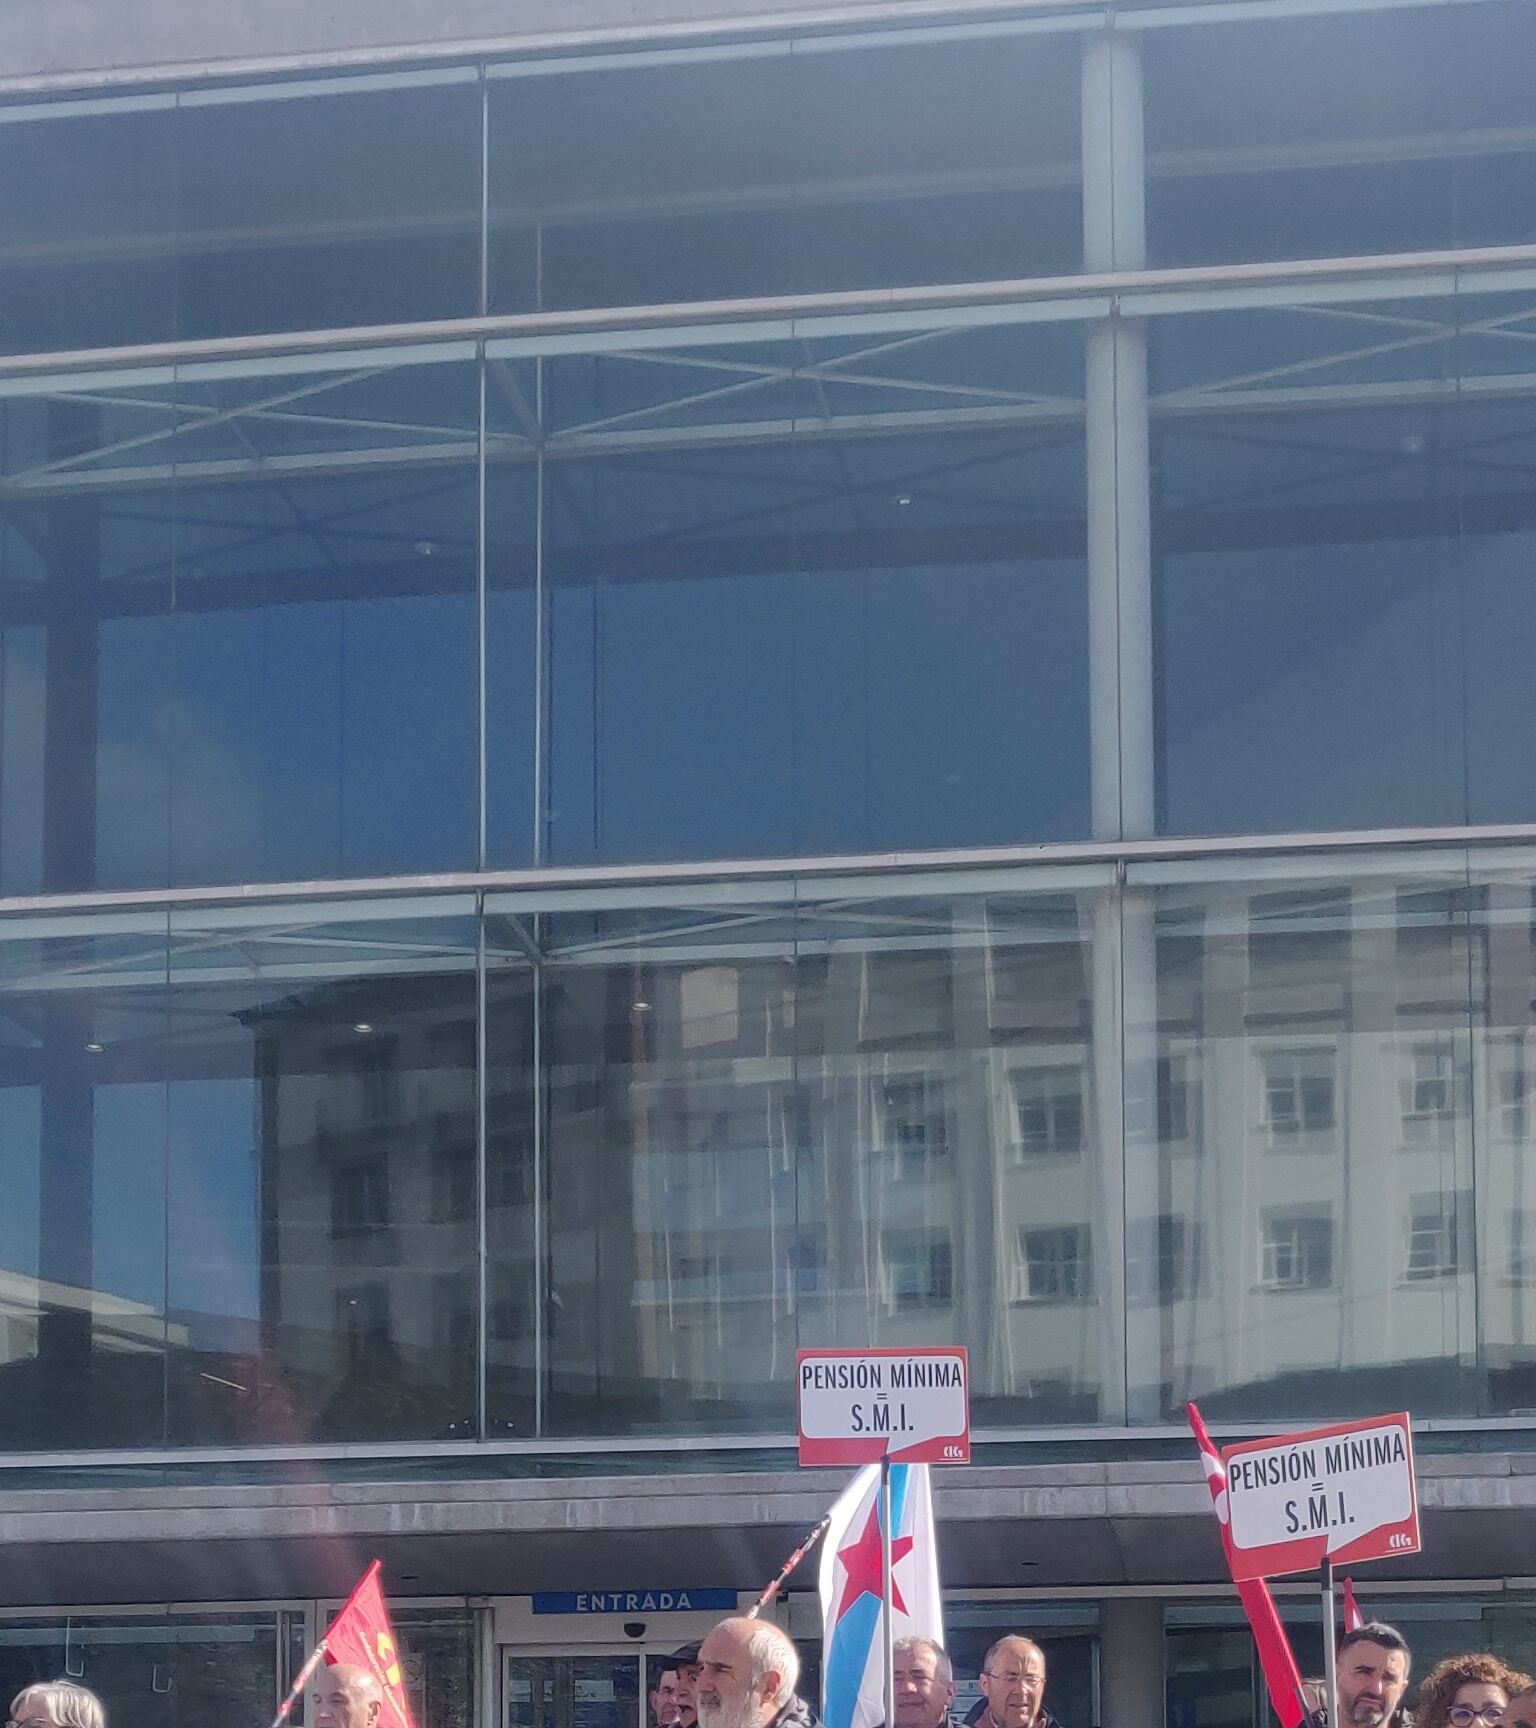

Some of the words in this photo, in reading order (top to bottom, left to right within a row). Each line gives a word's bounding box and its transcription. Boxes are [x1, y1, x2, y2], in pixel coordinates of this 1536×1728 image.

[803, 1357, 882, 1389] PENSIÓN
[891, 1356, 962, 1388] MÍNIMA
[851, 1403, 914, 1432] S.M.I.
[1229, 1446, 1316, 1492] PENSIÓN
[1326, 1433, 1406, 1475] MÍNIMA
[1286, 1491, 1355, 1534] S.M.I.
[576, 1591, 693, 1612] ENTRADA
